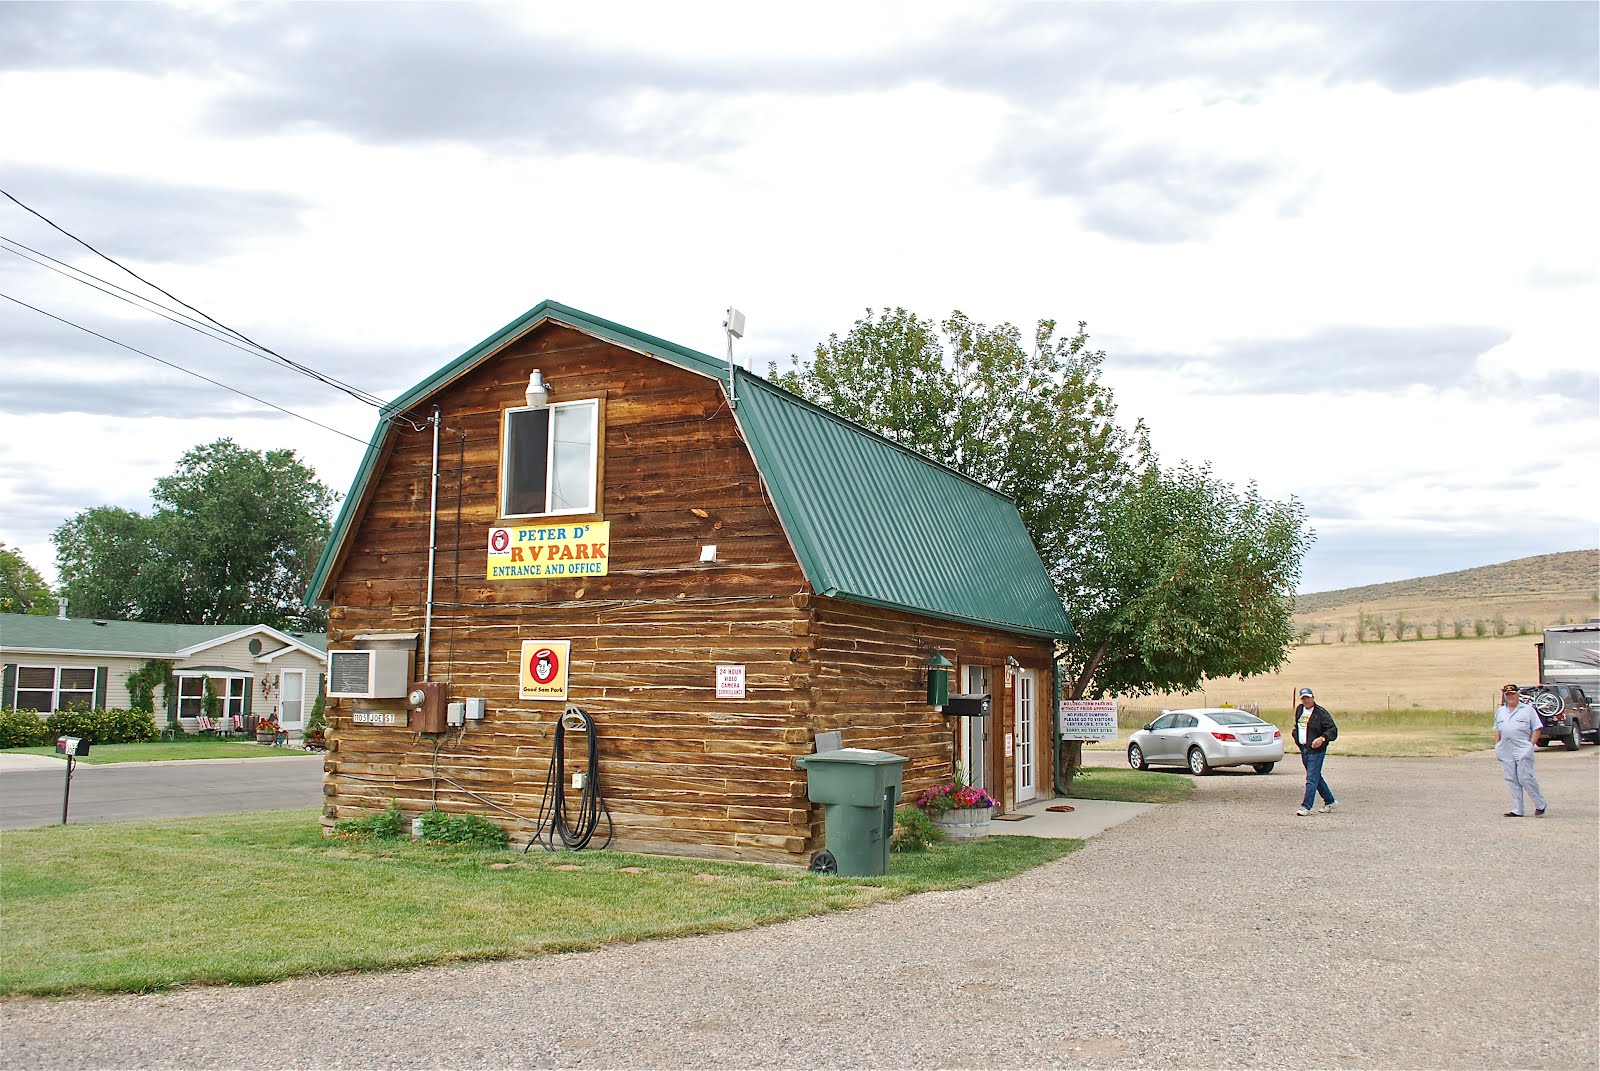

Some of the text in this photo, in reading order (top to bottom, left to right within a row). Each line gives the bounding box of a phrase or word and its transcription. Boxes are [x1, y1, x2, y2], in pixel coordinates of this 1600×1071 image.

[518, 528, 567, 542] PETER
[547, 543, 607, 560] PARK
[492, 562, 602, 577] ENTRANCE AND OFFICE
